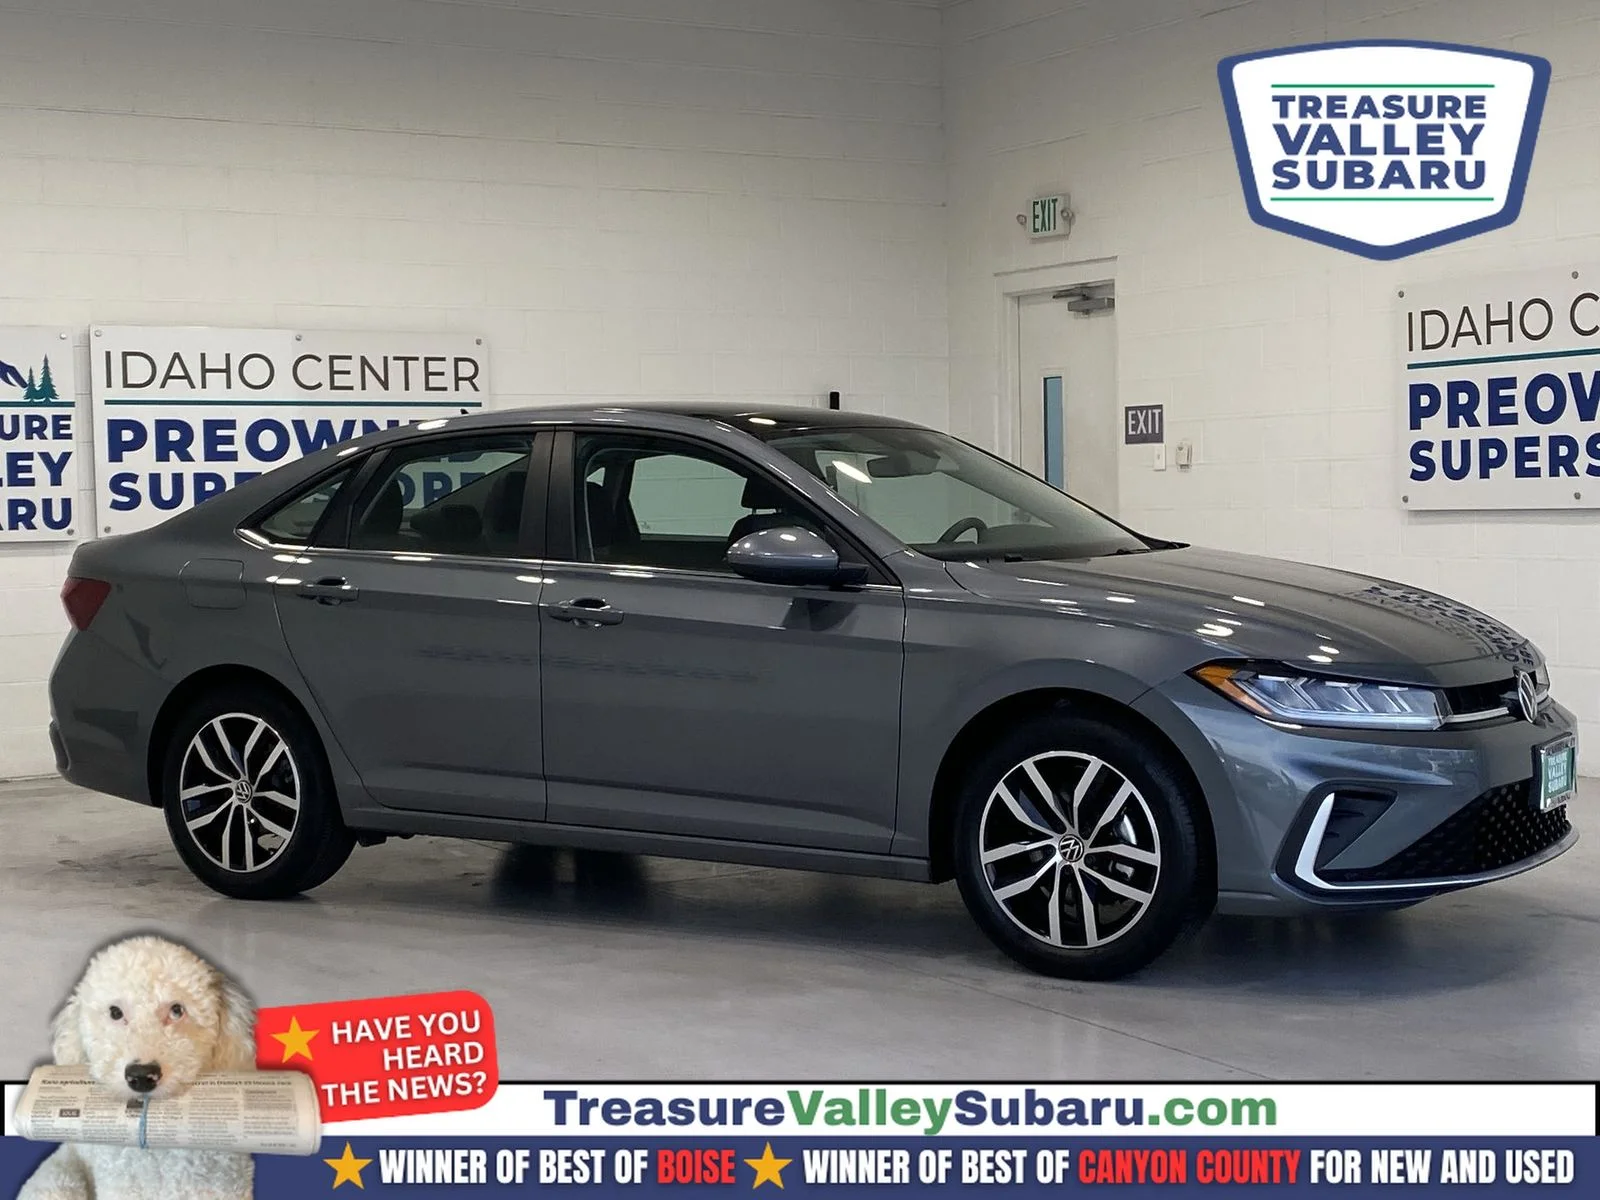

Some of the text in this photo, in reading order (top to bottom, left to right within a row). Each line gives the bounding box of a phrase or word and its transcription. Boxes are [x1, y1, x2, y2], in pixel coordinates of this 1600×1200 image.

[1032, 198, 1058, 233] EXIT
[1407, 298, 1554, 352] IDAHO
[105, 350, 480, 392] IDAHO CENTER
[0, 414, 73, 441] URE
[1127, 409, 1162, 435] EXIT
[0, 451, 73, 487] EY
[0, 498, 72, 531] RU
